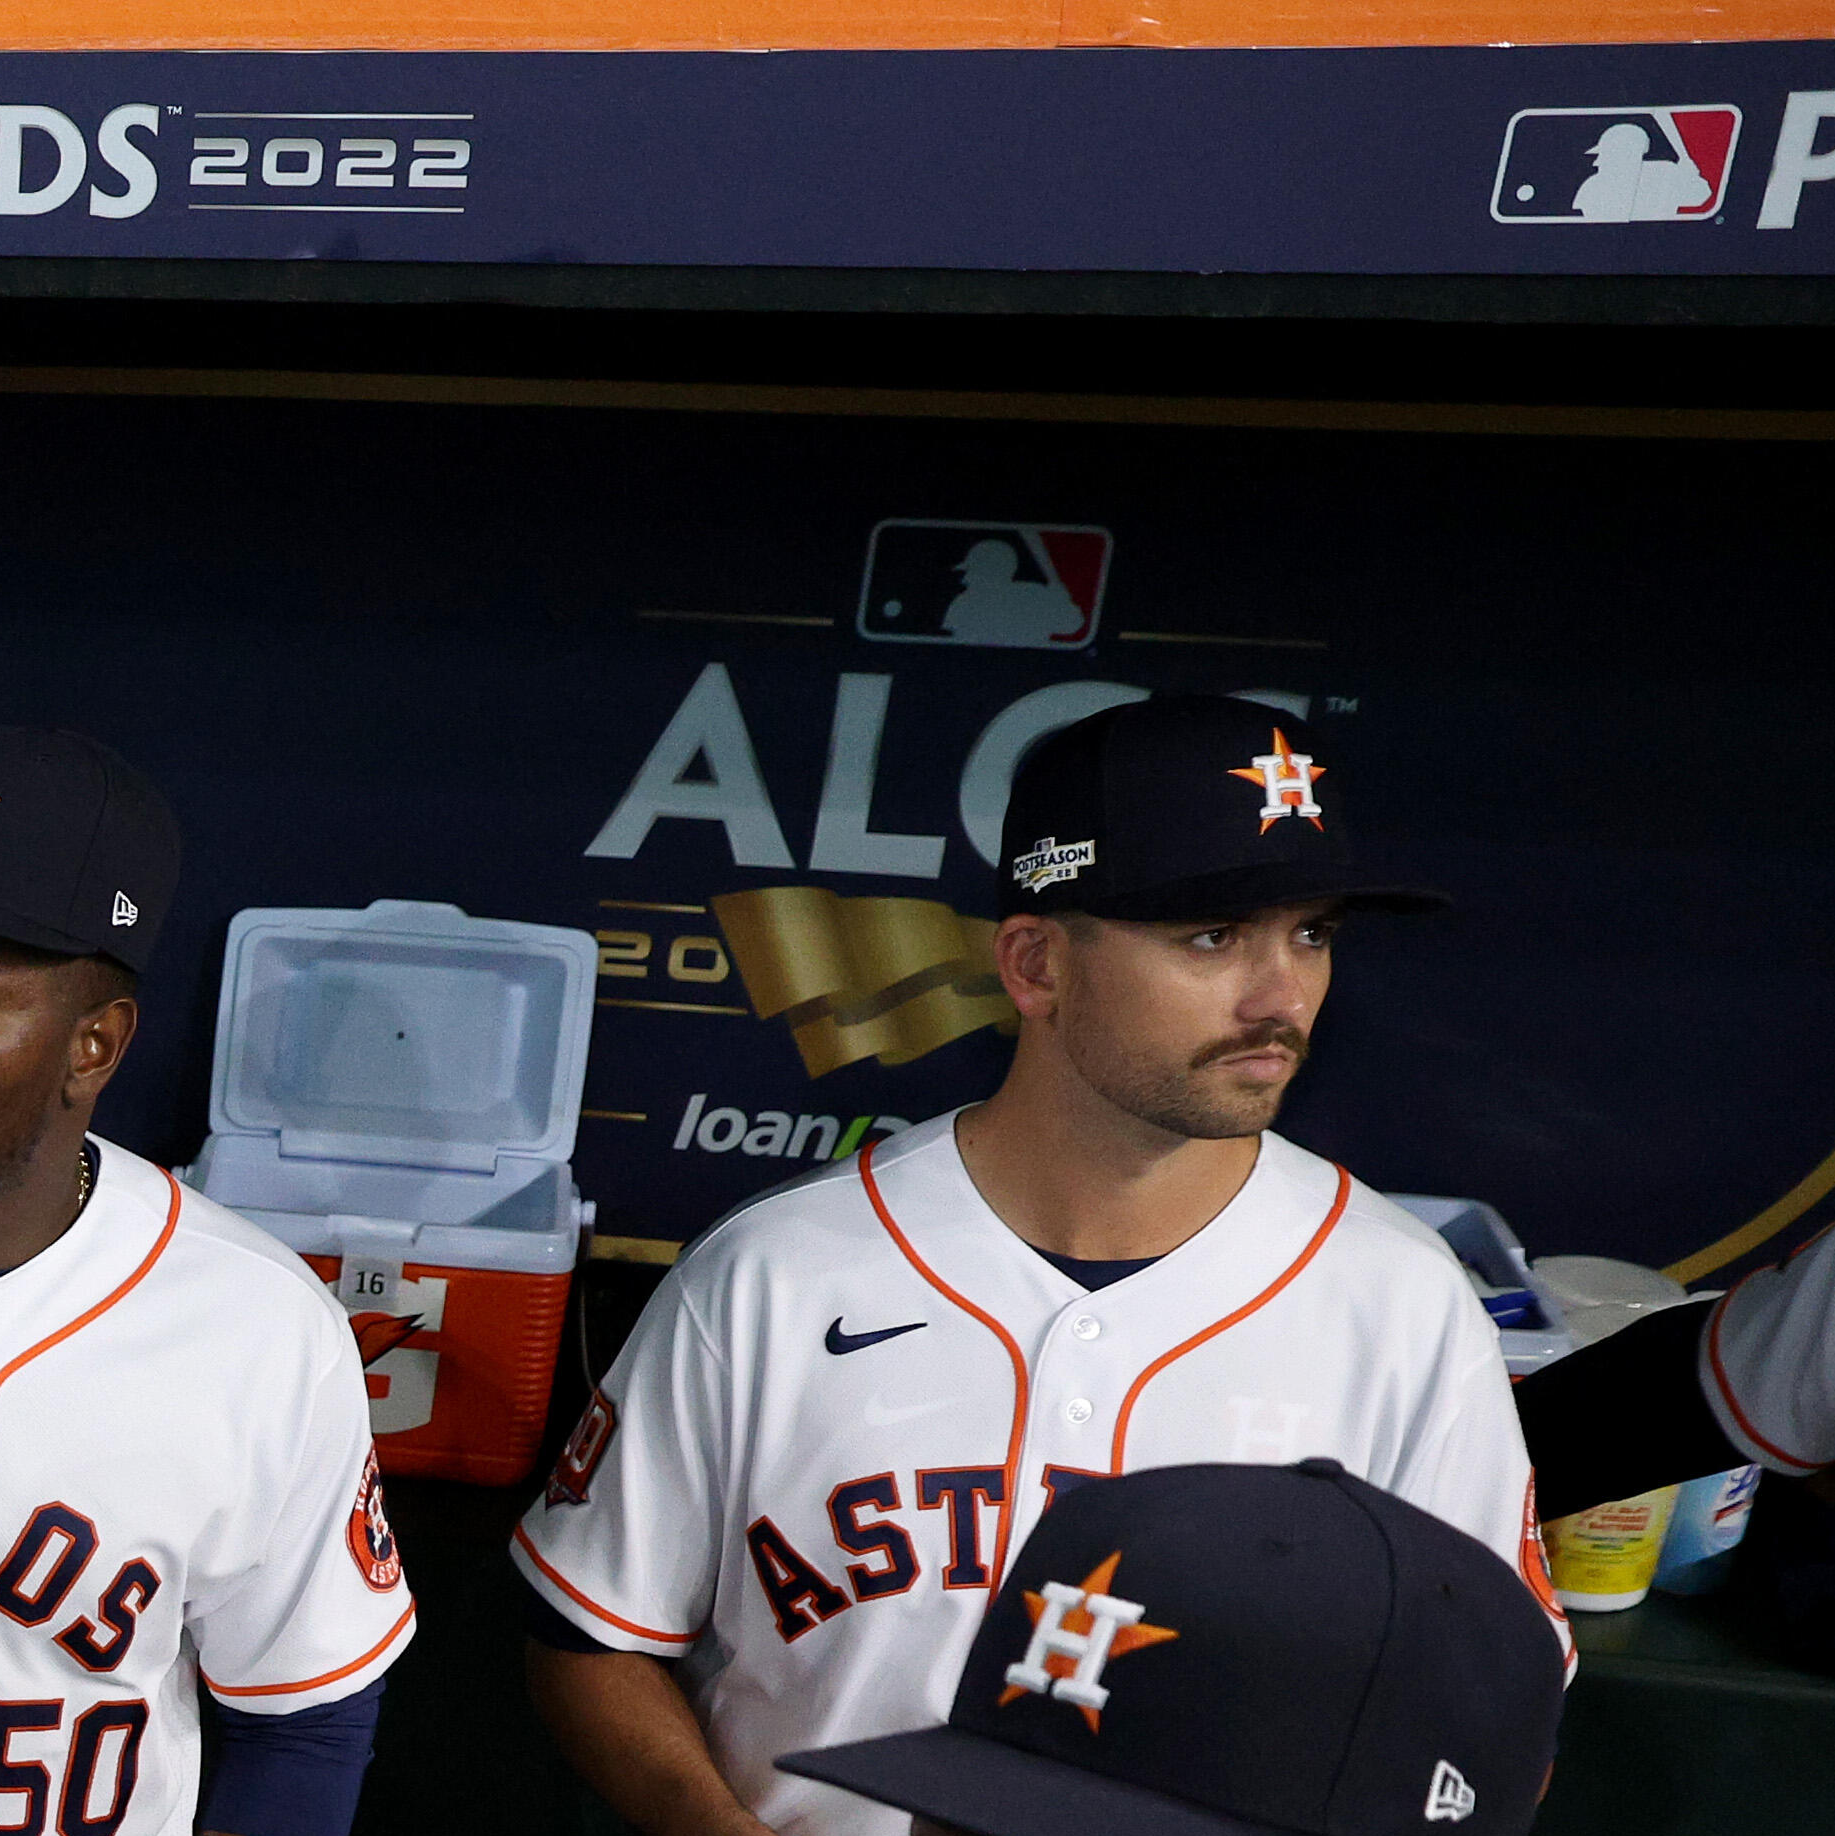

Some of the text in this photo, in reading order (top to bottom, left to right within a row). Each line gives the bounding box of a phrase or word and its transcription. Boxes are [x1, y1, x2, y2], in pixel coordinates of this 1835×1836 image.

[188, 137, 471, 188] 2022
[354, 1270, 385, 1296] 16
[1005, 1580, 1146, 1710] H
